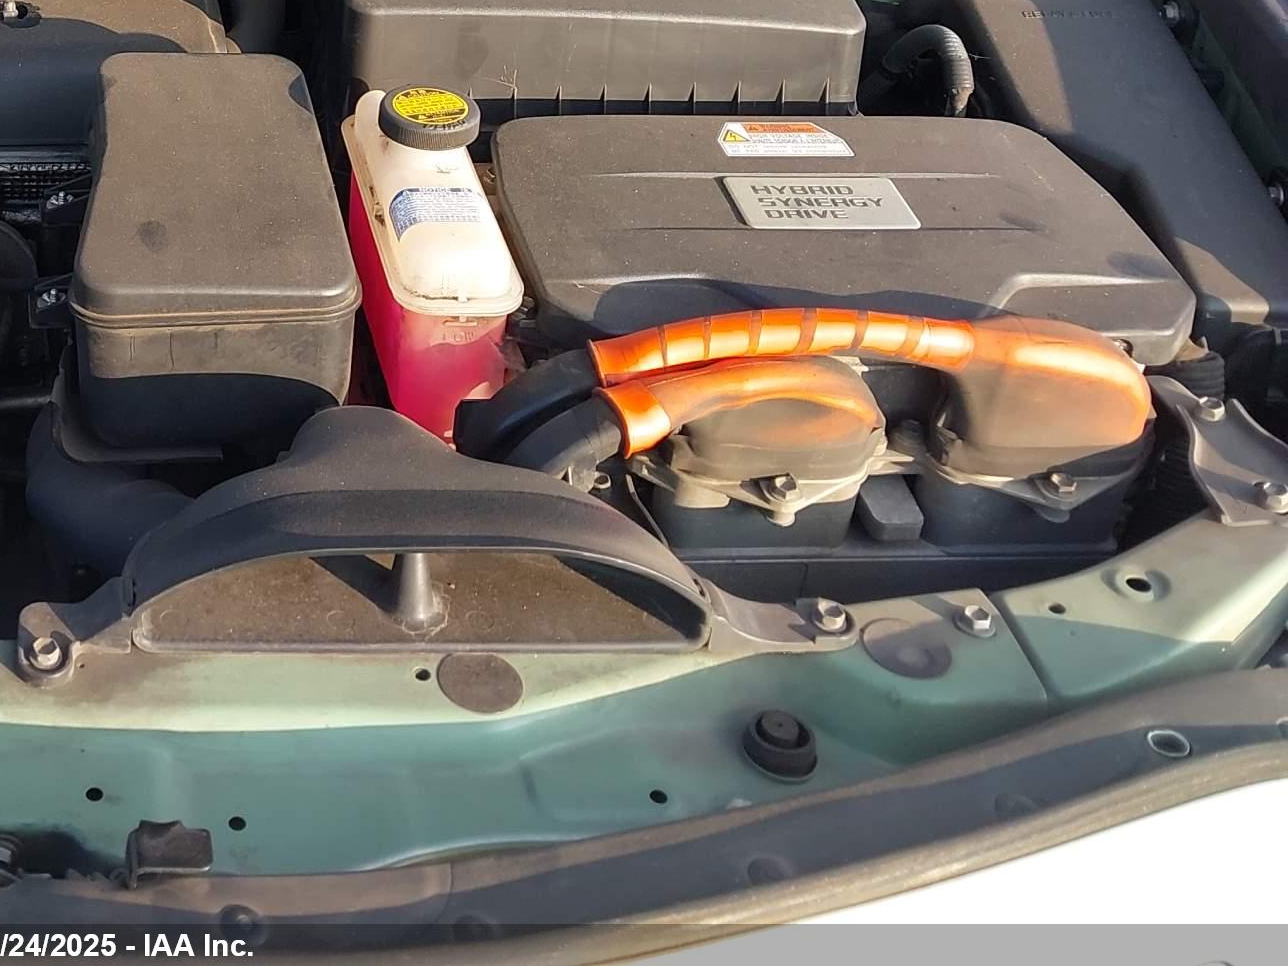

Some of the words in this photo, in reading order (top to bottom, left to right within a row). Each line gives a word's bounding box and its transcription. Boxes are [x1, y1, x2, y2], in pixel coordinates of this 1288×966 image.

[750, 185, 854, 195] HYBRID
[758, 197, 884, 208] SYNERGY
[764, 209, 849, 219] DRIVE
